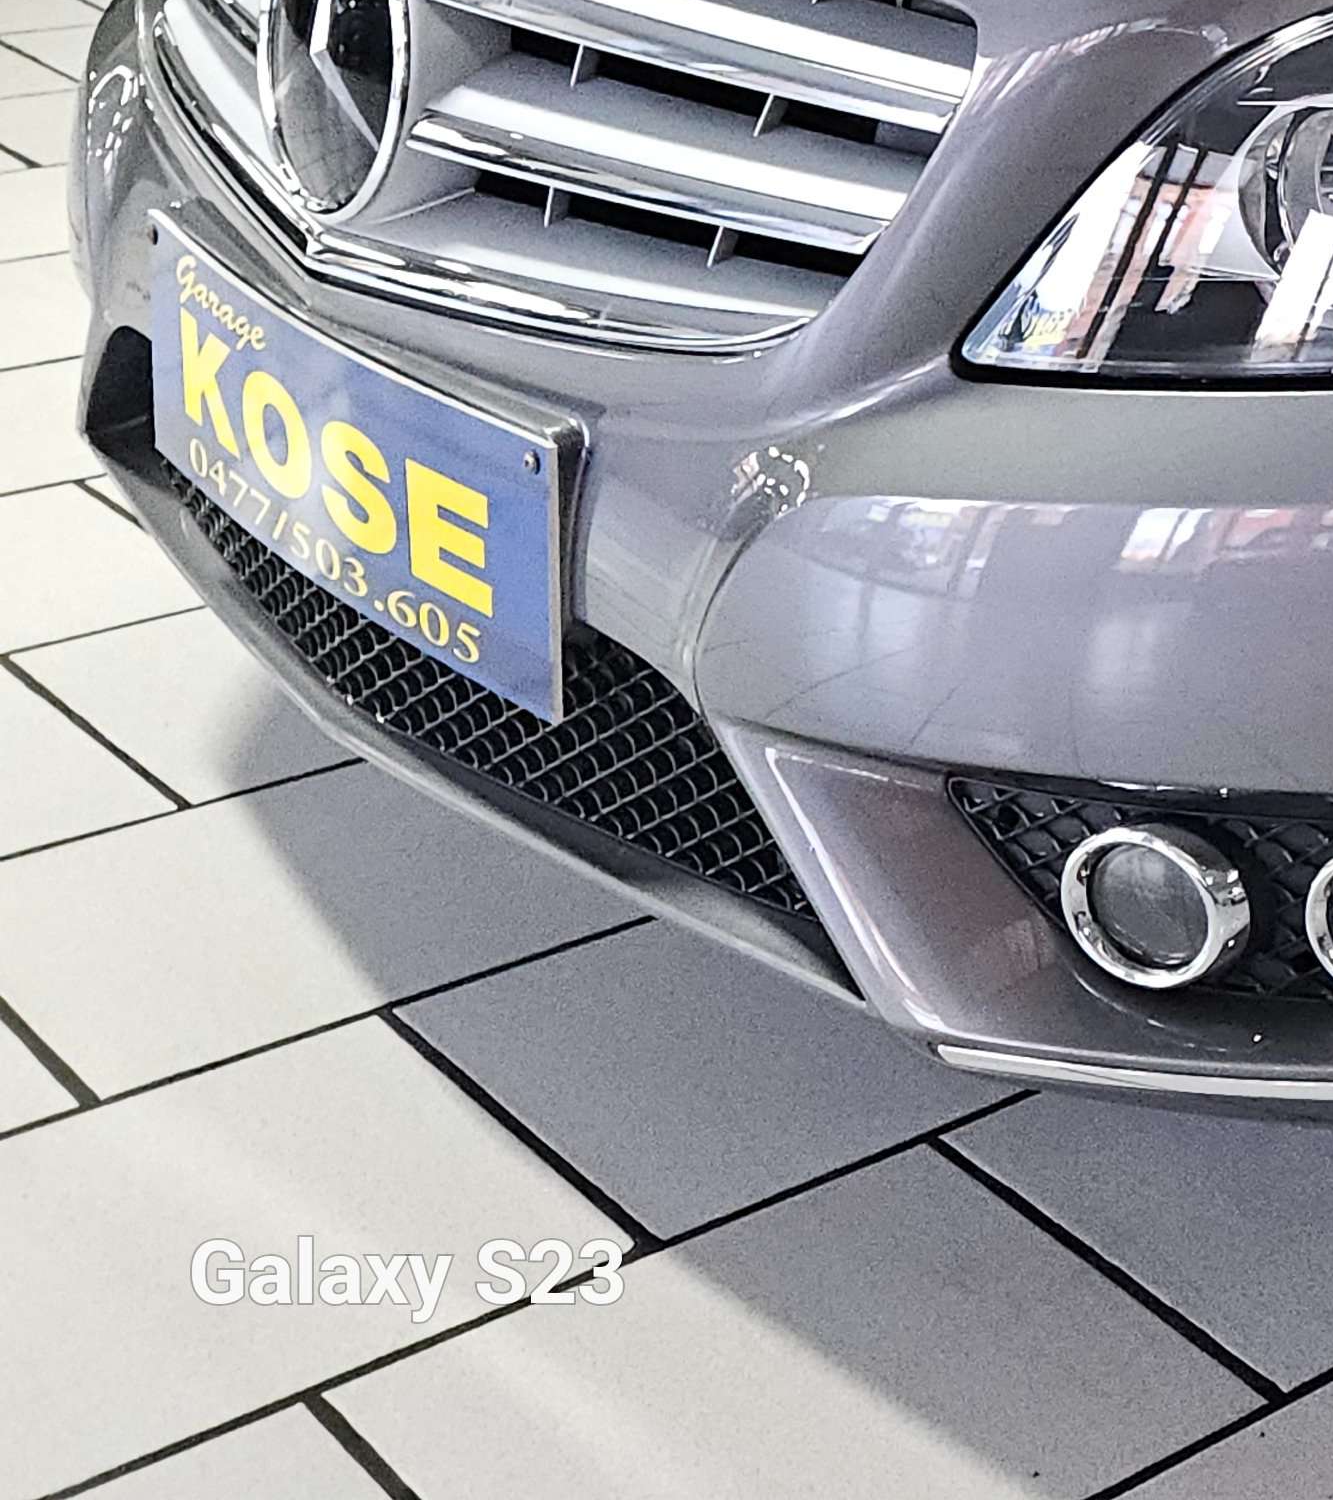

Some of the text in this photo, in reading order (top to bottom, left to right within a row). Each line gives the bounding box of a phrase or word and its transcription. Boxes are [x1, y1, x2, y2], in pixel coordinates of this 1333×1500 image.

[176, 255, 266, 351] Garage
[180, 306, 493, 619] KOSE
[189, 438, 480, 663] 0477/503.605
